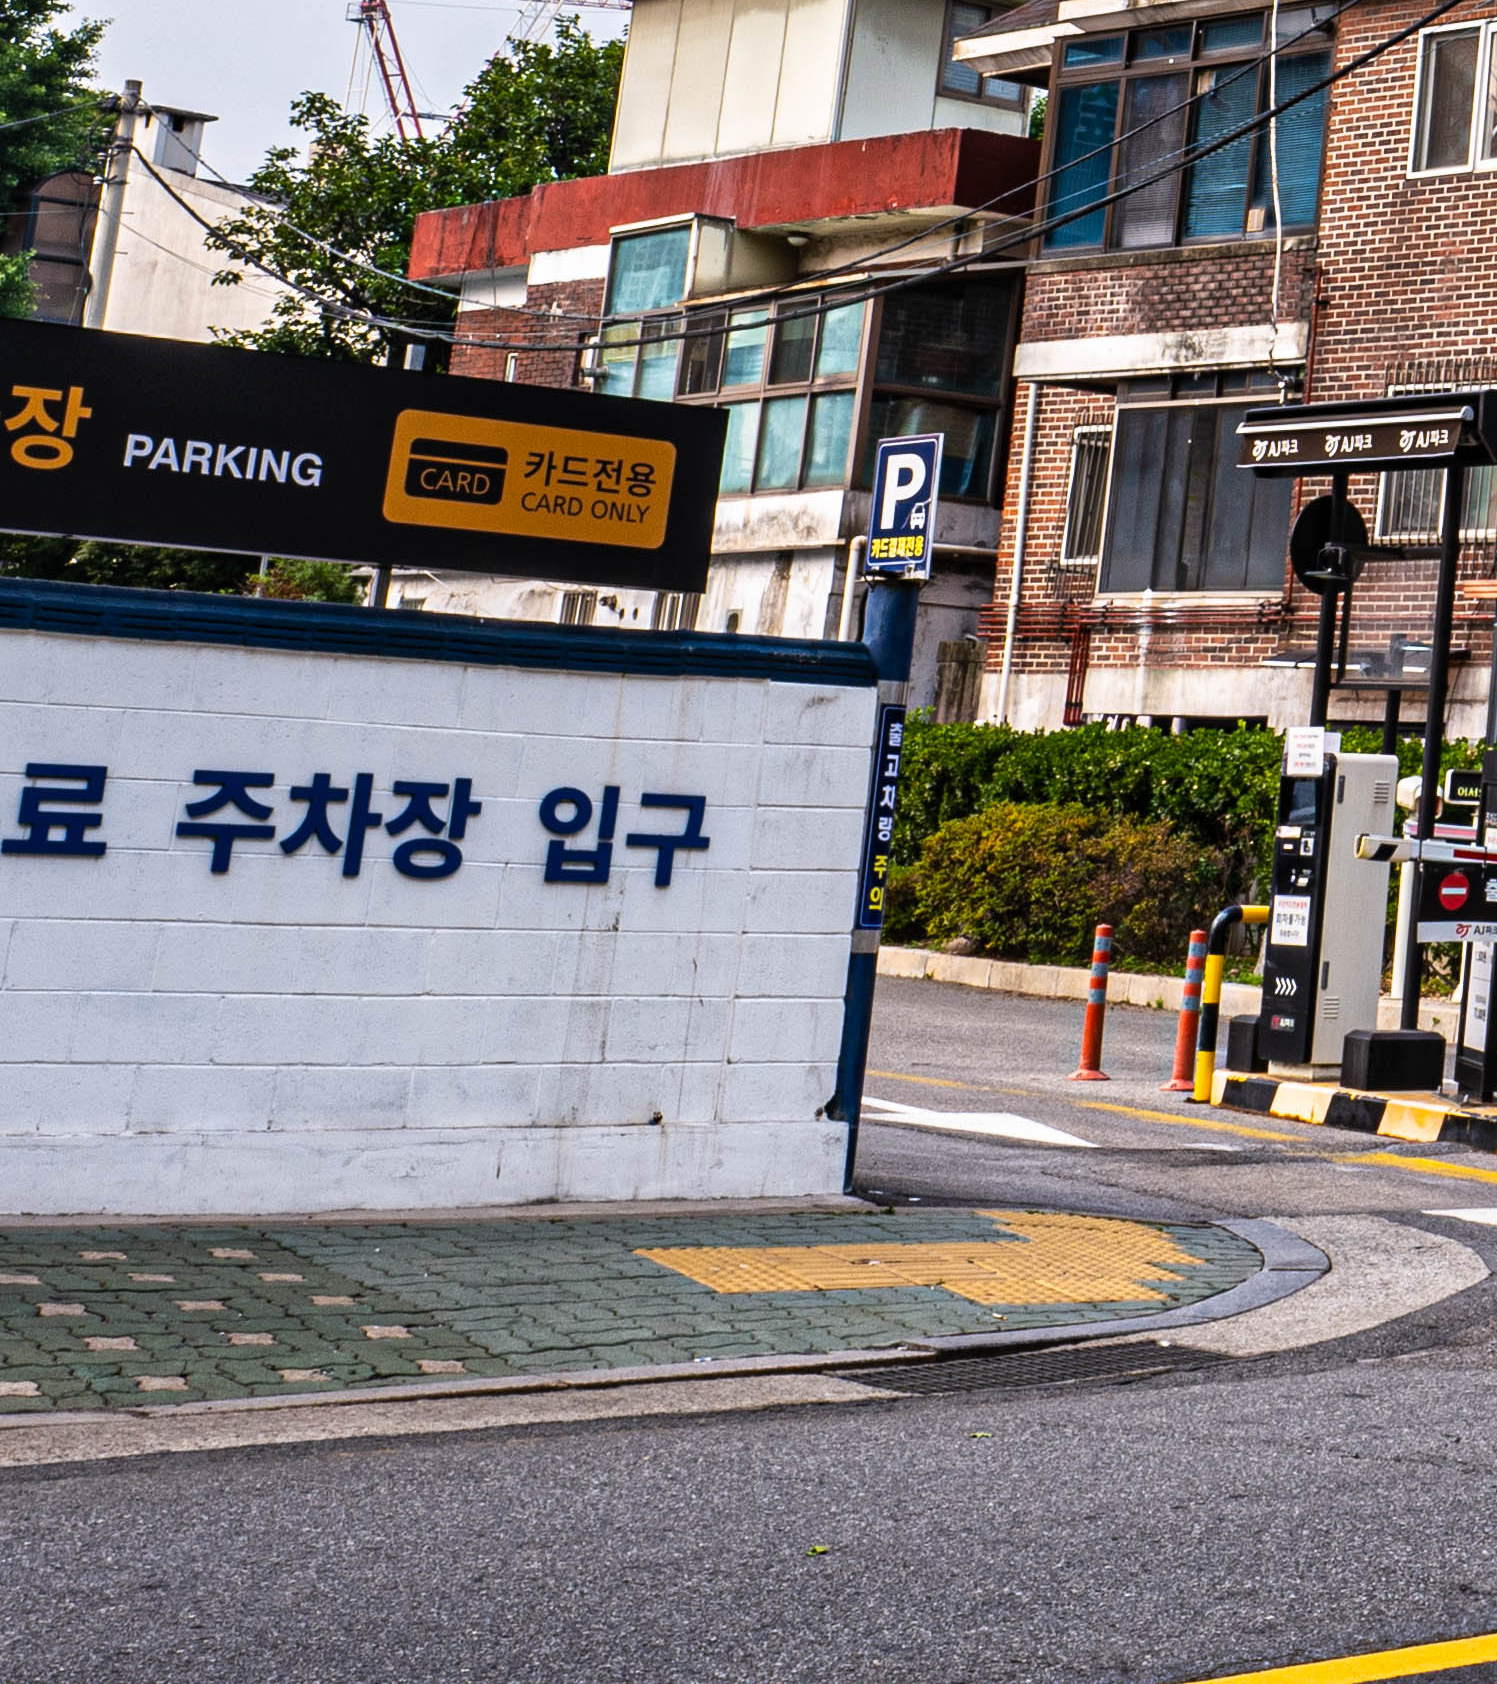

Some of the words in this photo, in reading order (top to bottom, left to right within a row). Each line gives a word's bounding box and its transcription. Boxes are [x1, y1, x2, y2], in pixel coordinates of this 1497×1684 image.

[4, 385, 92, 469] 장
[123, 434, 323, 486] PARKING
[420, 467, 490, 495] CARD
[524, 451, 656, 498] 카드전용
[521, 492, 583, 516] CARD
[591, 499, 651, 524] ONLY
[881, 453, 926, 529] P
[0, 762, 108, 858] 료
[176, 769, 482, 883] 주차장
[538, 785, 711, 889] 입구
[869, 855, 888, 911] 주의
